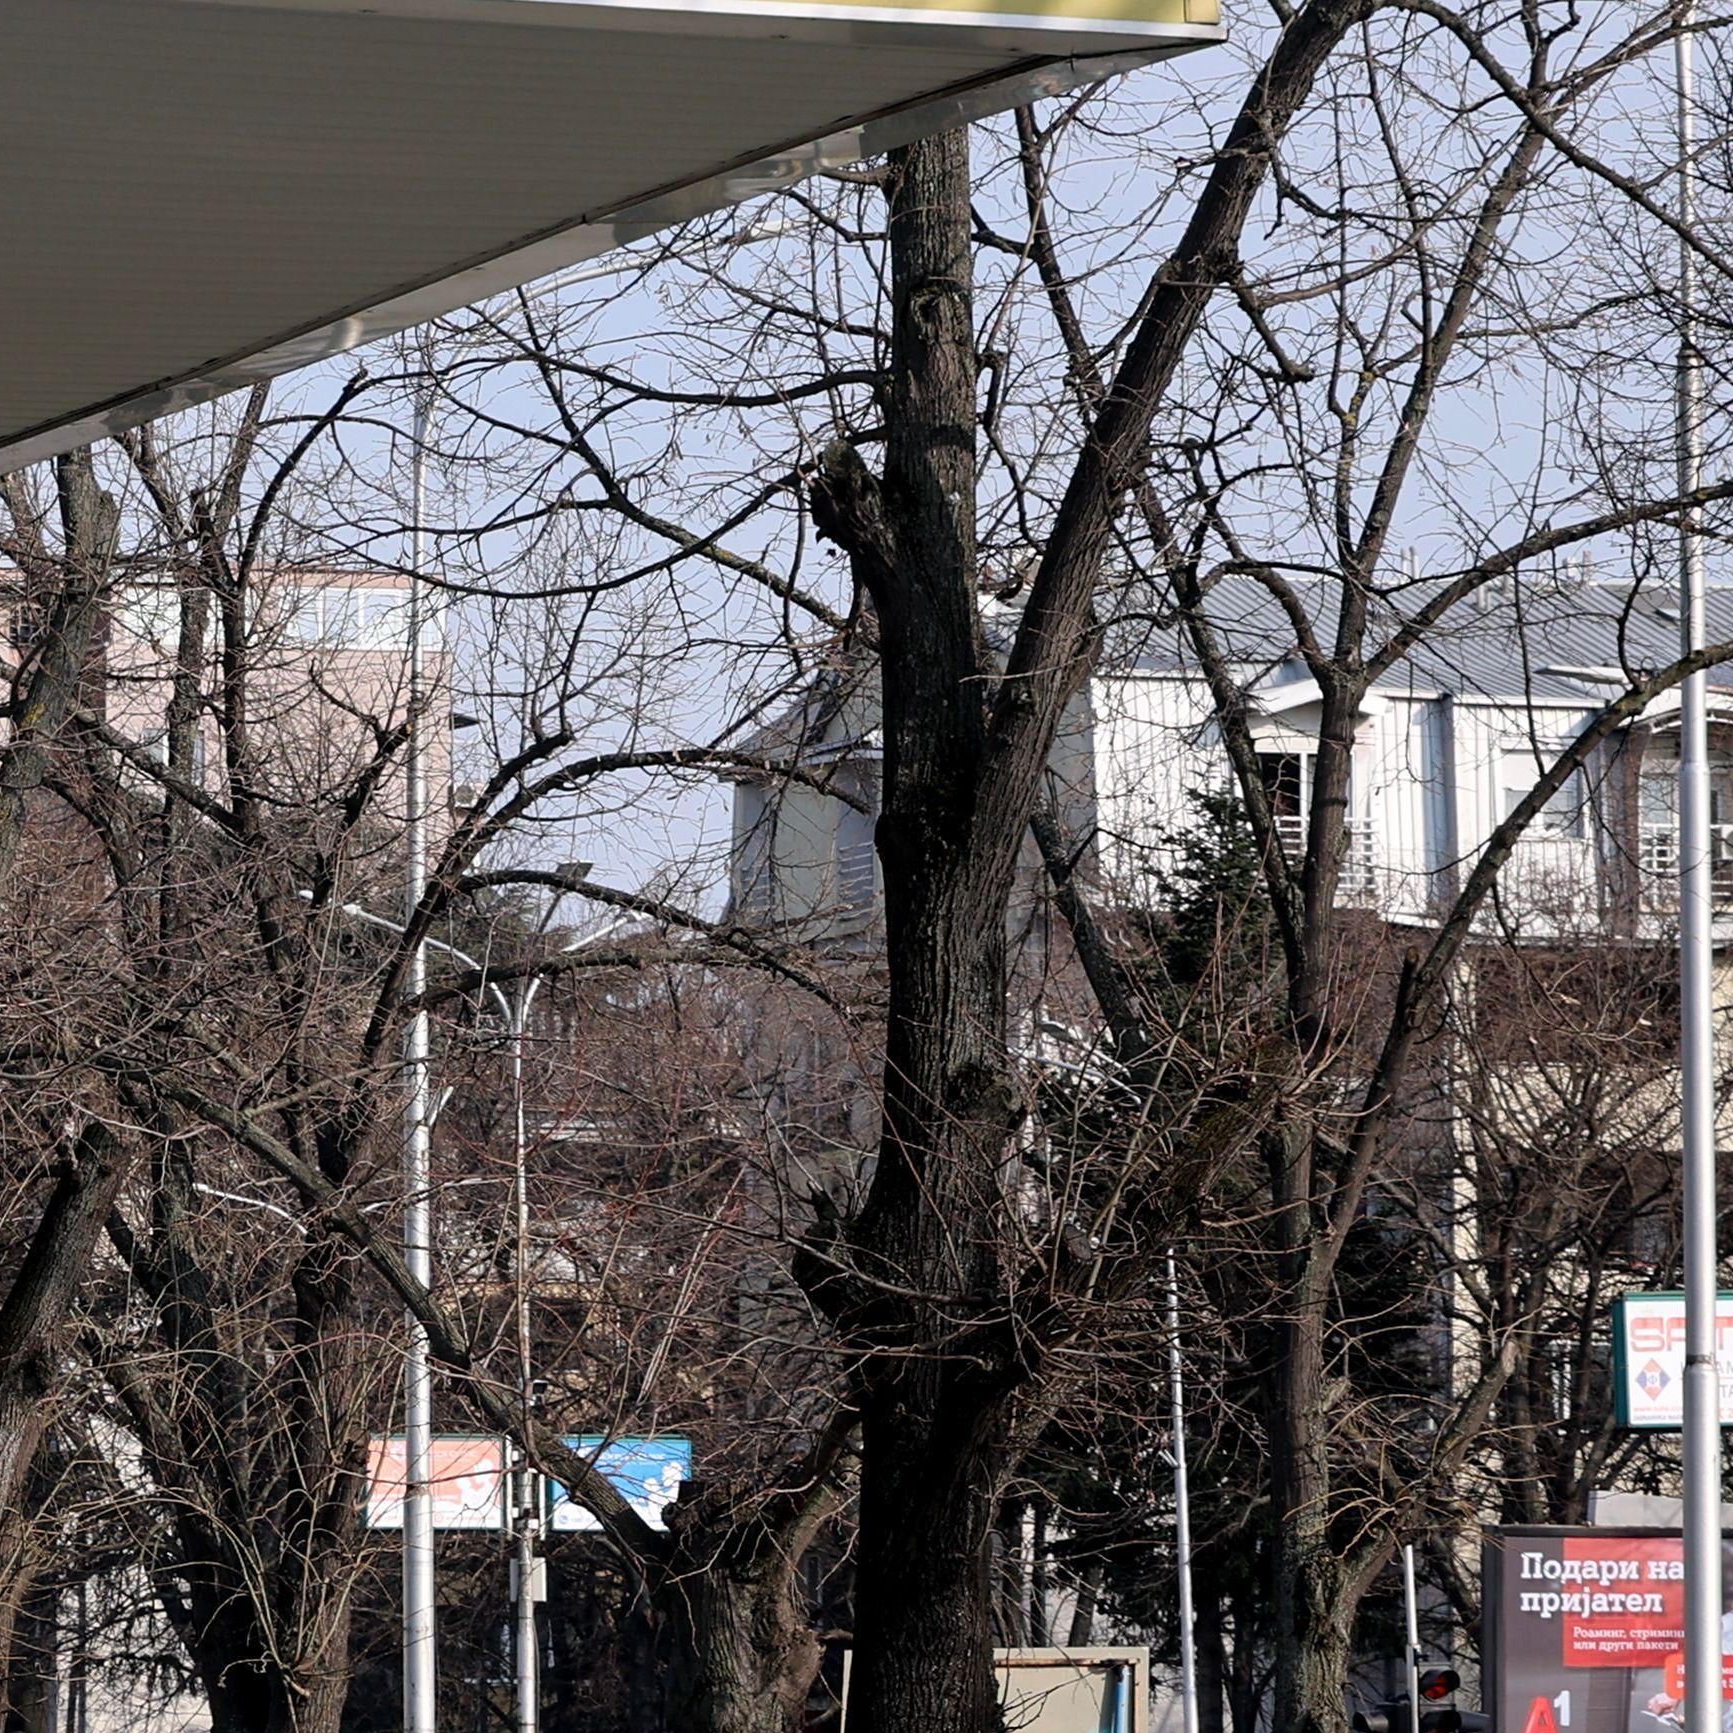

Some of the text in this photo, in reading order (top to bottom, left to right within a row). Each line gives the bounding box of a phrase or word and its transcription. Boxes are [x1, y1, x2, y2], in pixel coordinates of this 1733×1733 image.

[1519, 1551, 1640, 1587] Подари
[1519, 1586, 1664, 1618] пријател
[1599, 1641, 1634, 1653] други
[1636, 1641, 1679, 1651] пакети
